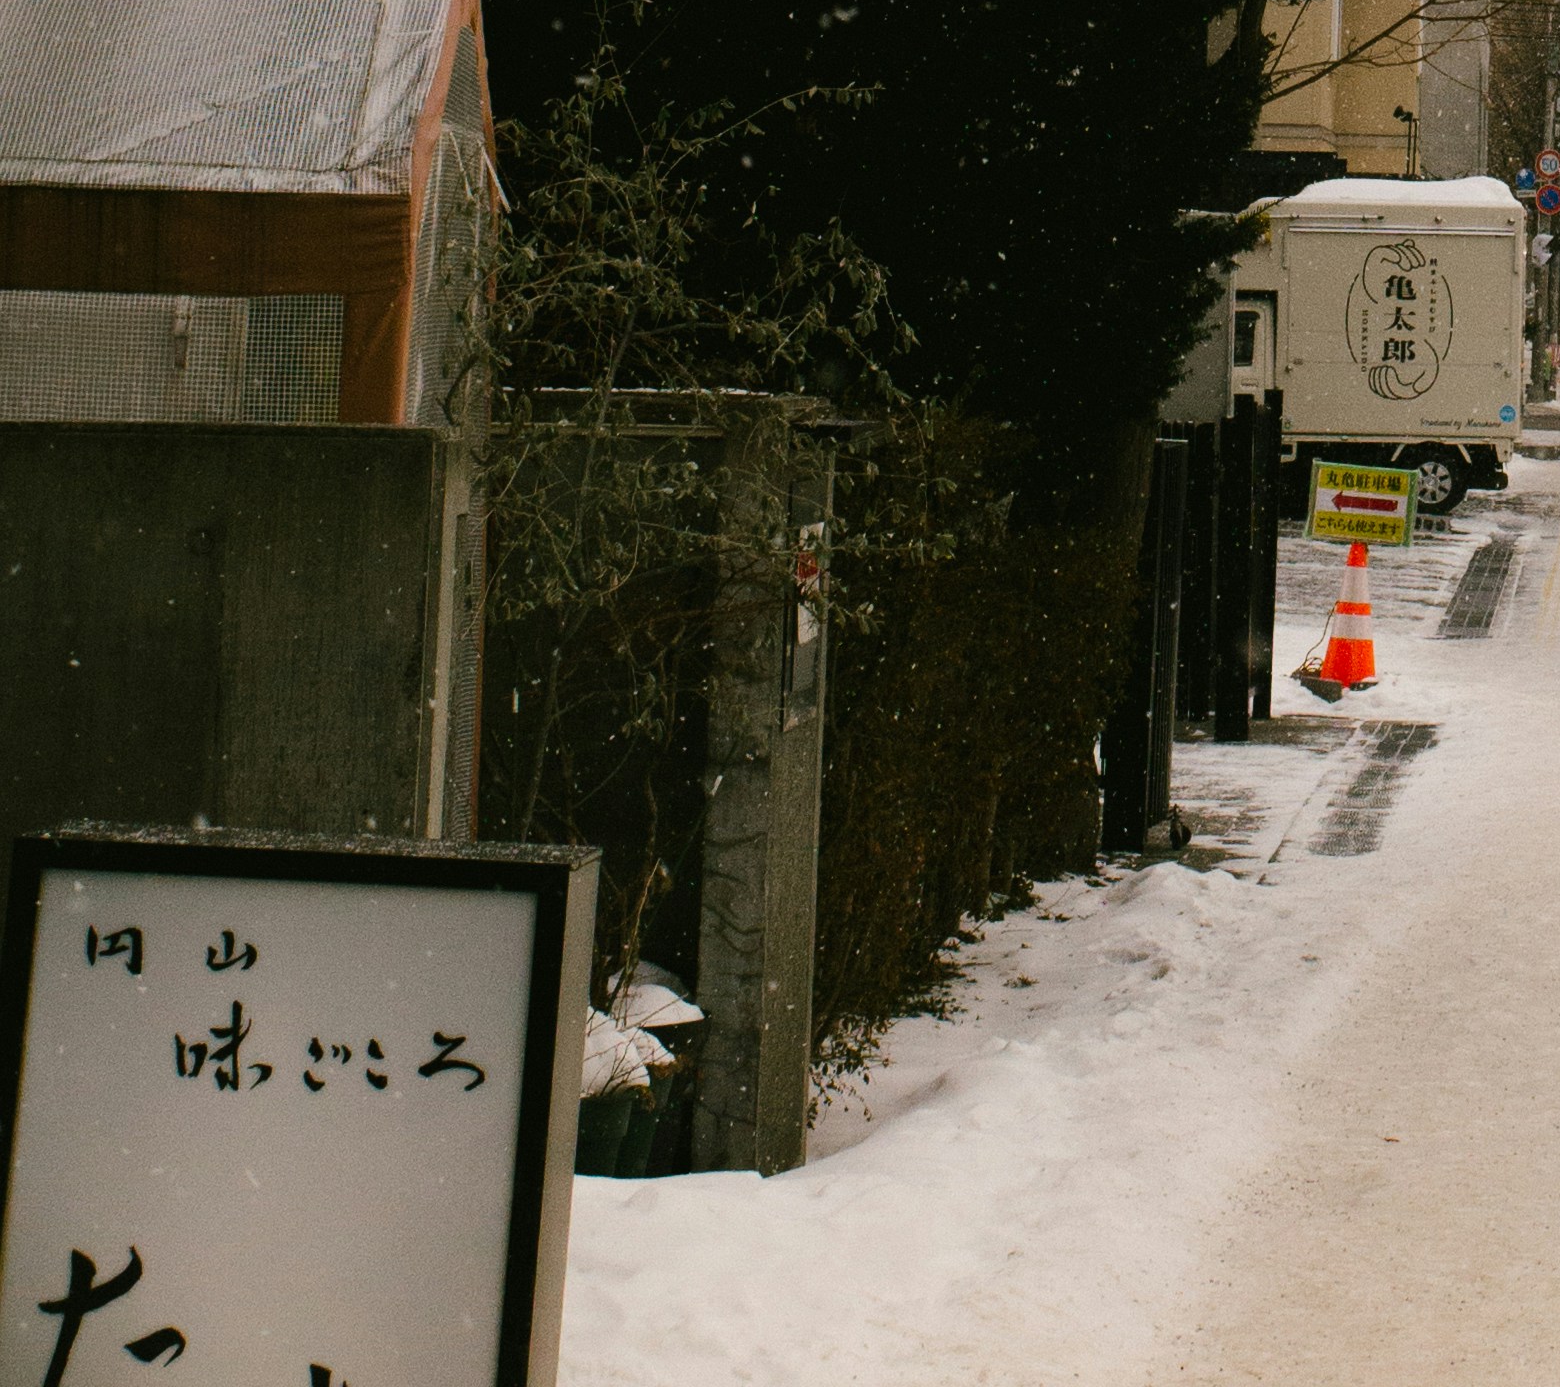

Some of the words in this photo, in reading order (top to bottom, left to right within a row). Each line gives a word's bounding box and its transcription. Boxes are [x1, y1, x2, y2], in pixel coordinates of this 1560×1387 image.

[1541, 157, 1558, 172] 50
[1381, 275, 1417, 364] 亀太郎
[1326, 470, 1401, 492] 丸亀駐車場
[1316, 517, 1400, 536] こちらも使えます
[85, 924, 259, 976] 円山
[173, 999, 487, 1092] 味ごころ
